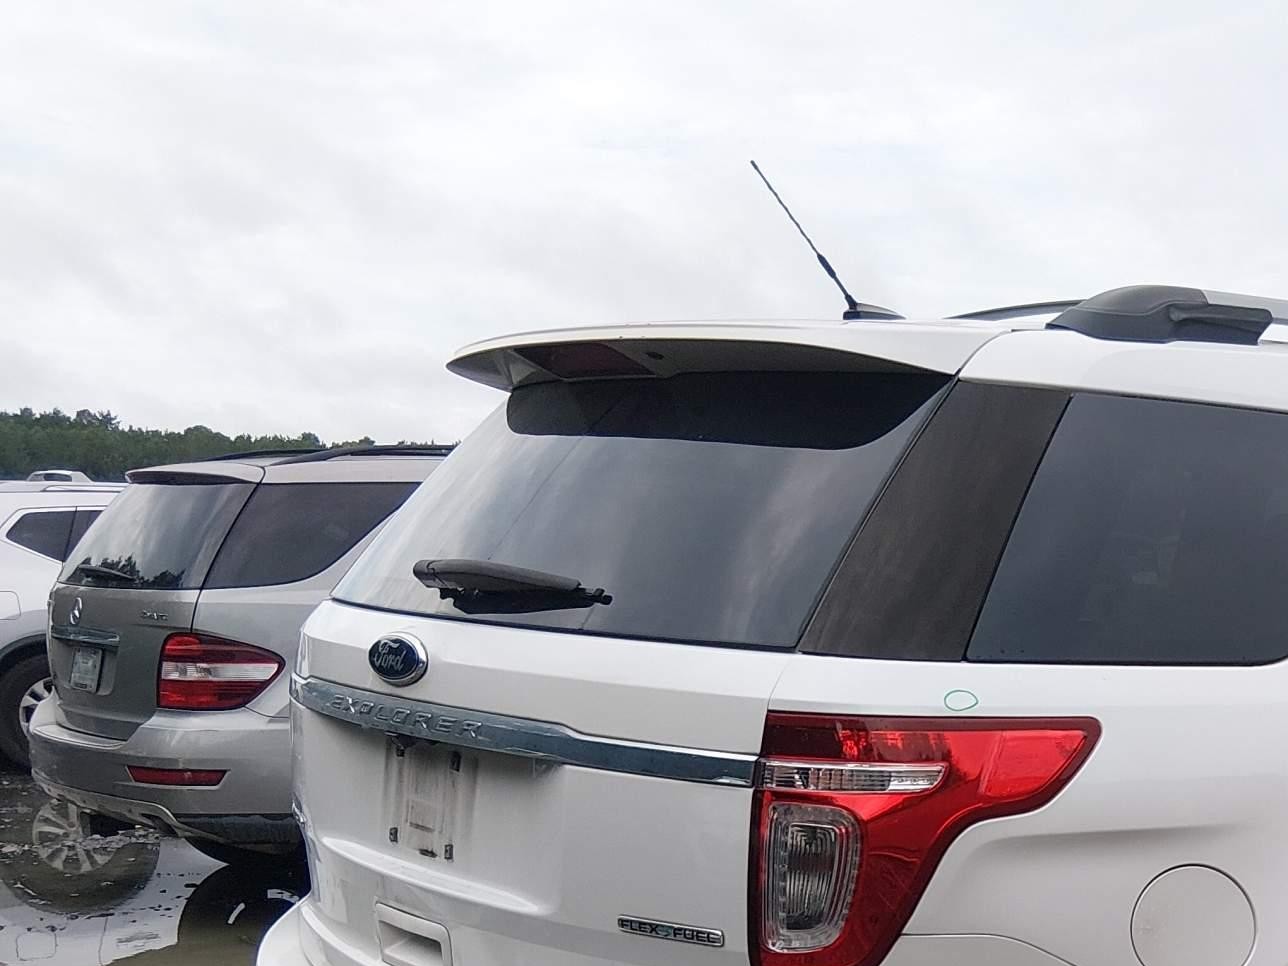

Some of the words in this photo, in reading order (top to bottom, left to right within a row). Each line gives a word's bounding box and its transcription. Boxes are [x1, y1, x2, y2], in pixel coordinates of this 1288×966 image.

[374, 639, 406, 671] Ford
[329, 694, 482, 737] EXPLORER
[620, 919, 659, 934] FLEX
[673, 926, 721, 944] FUEL
